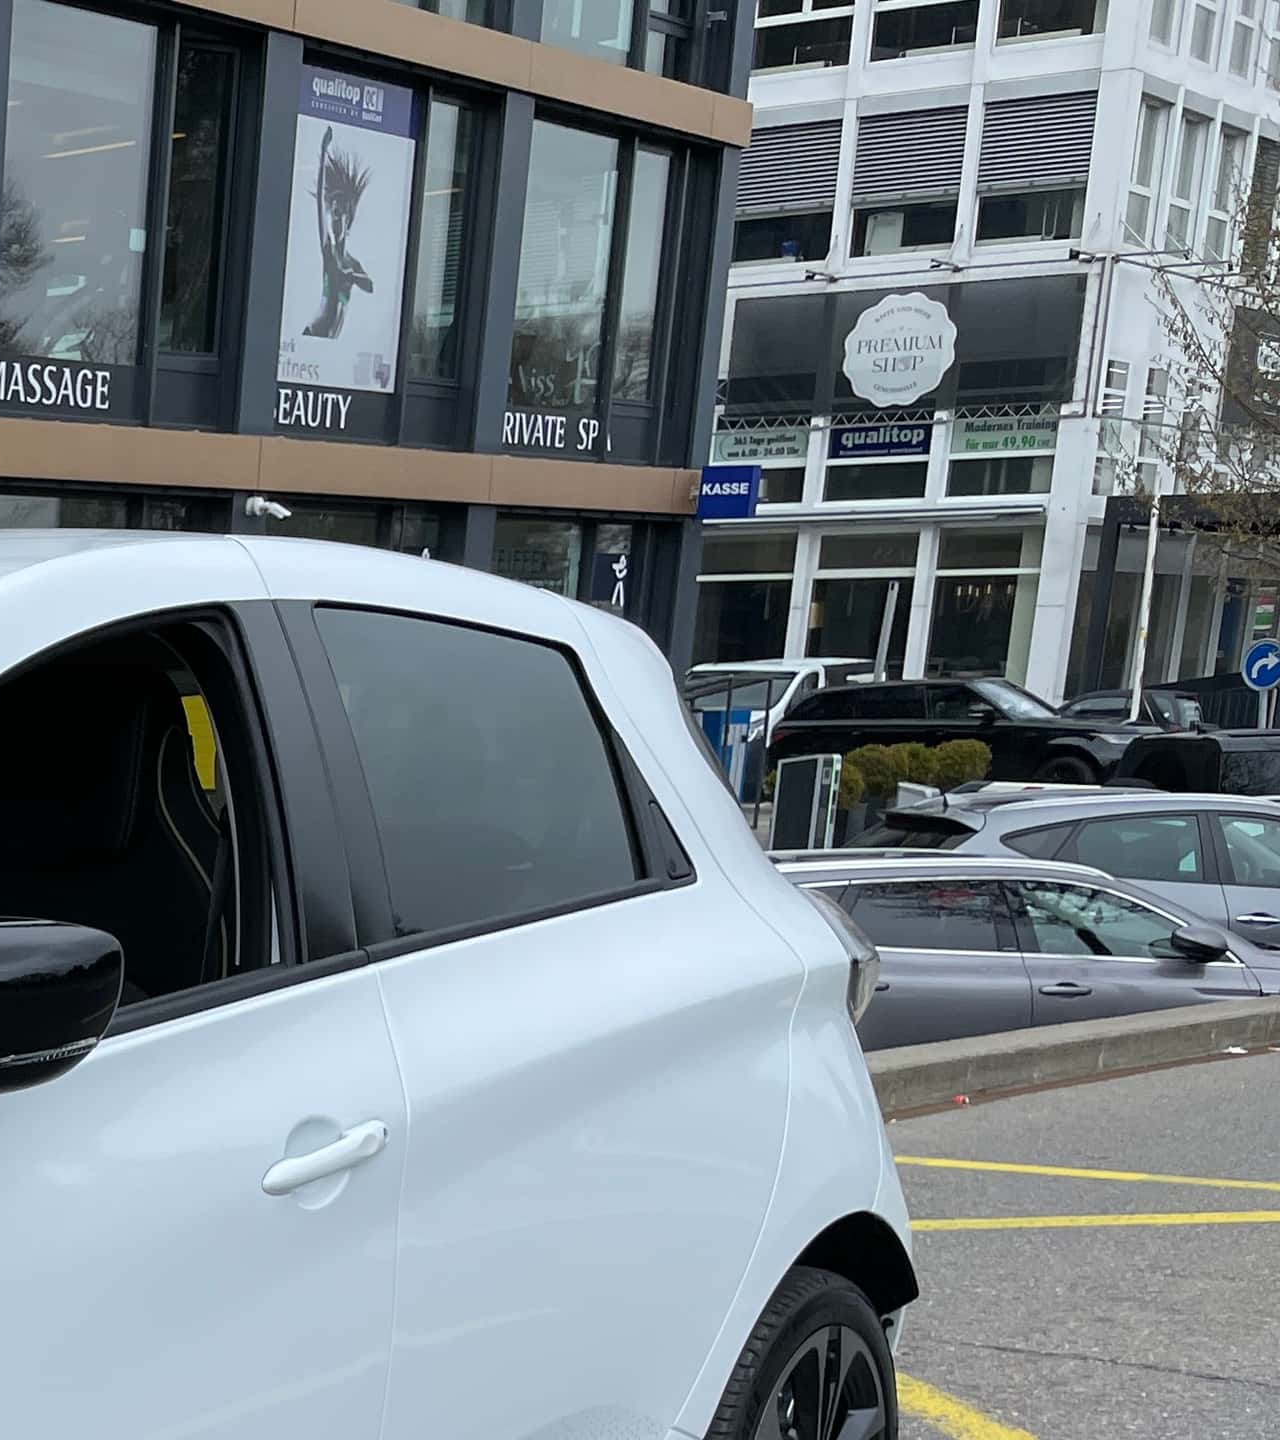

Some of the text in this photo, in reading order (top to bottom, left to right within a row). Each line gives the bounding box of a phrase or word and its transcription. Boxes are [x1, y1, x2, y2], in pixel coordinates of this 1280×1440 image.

[312, 77, 360, 105] qualitop
[857, 334, 943, 354] PREMIUM
[274, 387, 352, 429] EAUTY
[577, 418, 612, 452] SP
[1016, 416, 1057, 432] Training
[841, 426, 925, 448] qualitop
[701, 482, 750, 496] KASSE
